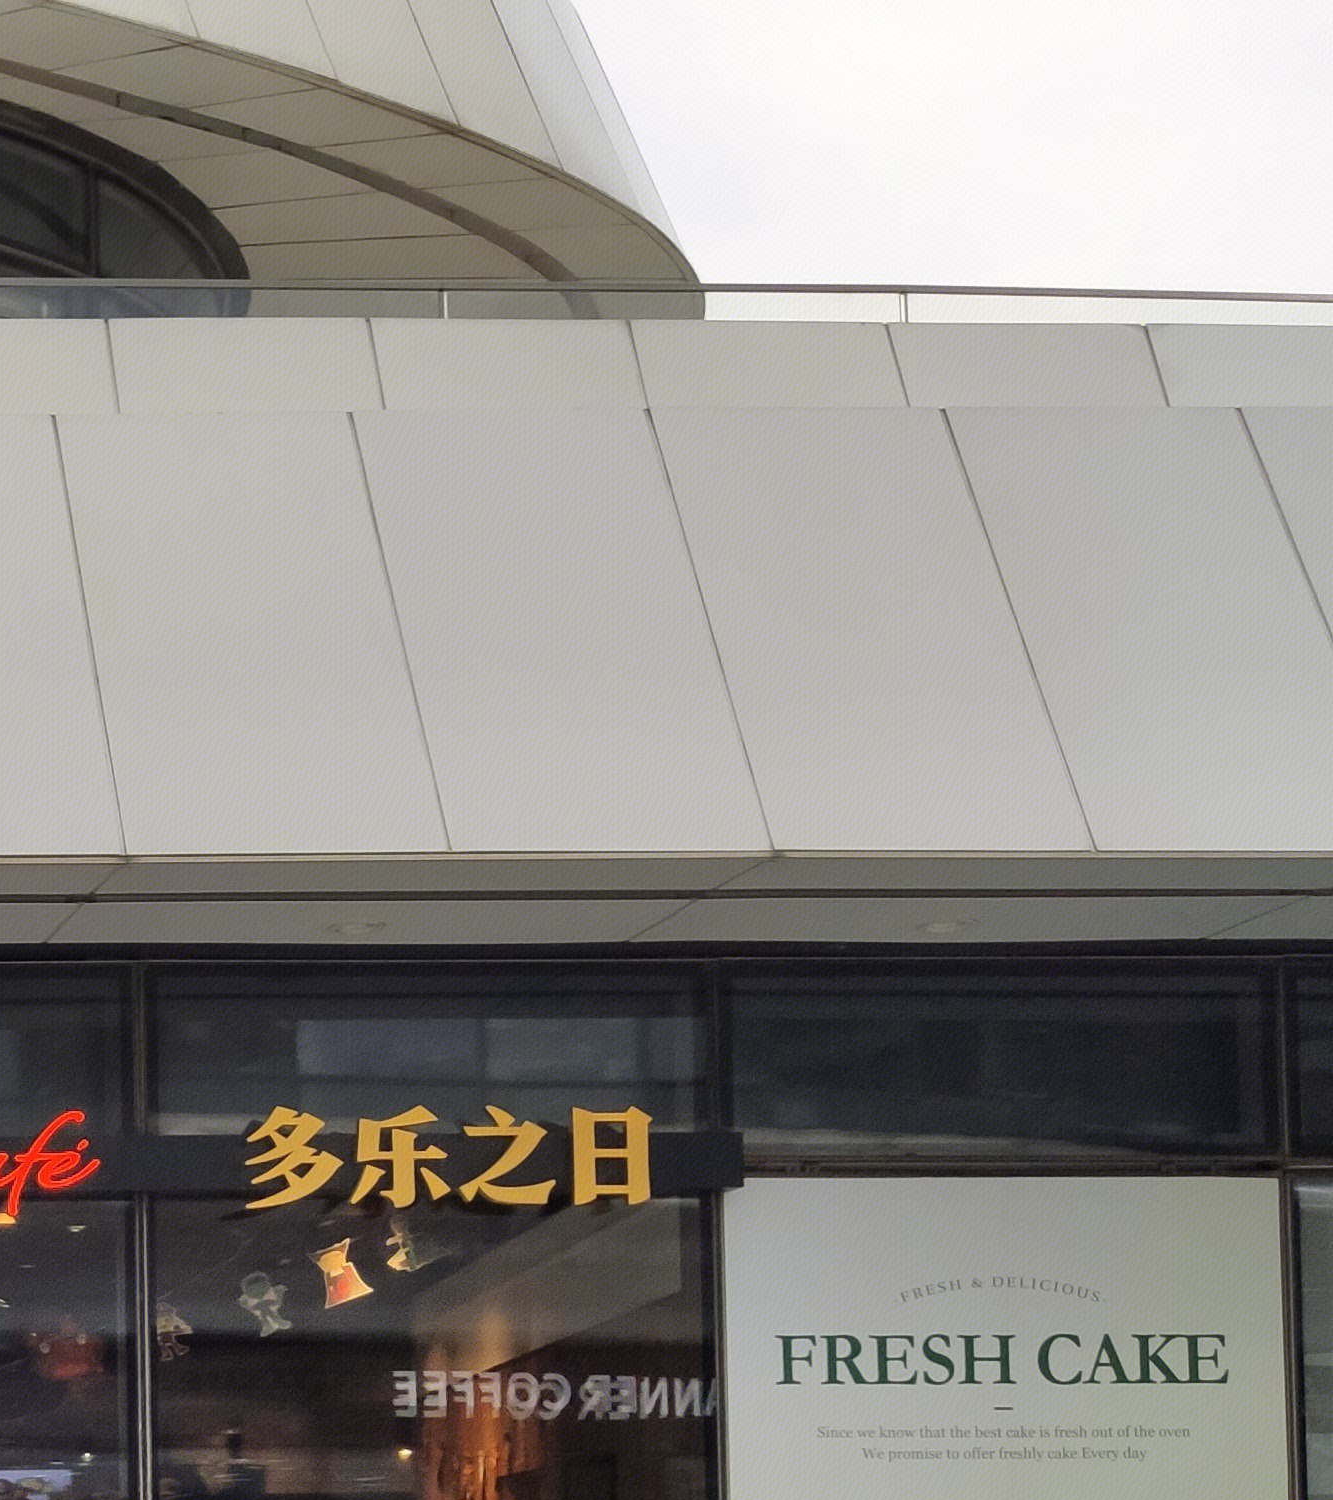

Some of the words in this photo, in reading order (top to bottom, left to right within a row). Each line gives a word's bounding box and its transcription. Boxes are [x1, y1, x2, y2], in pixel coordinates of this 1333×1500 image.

[244, 1104, 654, 1210] 多乐之日
[900, 1278, 962, 1303] FRESH
[971, 1277, 983, 1288] &
[992, 1276, 1100, 1302] DELICIOUS
[775, 1333, 1016, 1385] FRESH
[1037, 1332, 1230, 1385] CAKE
[817, 1426, 854, 1438] Since
[857, 1429, 875, 1438] we
[880, 1426, 915, 1438] know
[919, 1426, 945, 1438] that
[950, 1426, 971, 1438] the
[975, 1426, 1002, 1438] best
[1006, 1426, 1036, 1438] cake
[1040, 1426, 1050, 1438] is
[1054, 1425, 1087, 1438] fresh
[1091, 1427, 1112, 1438] out
[1117, 1425, 1132, 1438] of
[1134, 1426, 1155, 1438] the
[1158, 1428, 1190, 1438] oven
[862, 1447, 884, 1459] We
[889, 1447, 942, 1462] promise
[947, 1448, 959, 1459] to
[963, 1447, 995, 1459] offer
[999, 1447, 1043, 1462] freshly
[1047, 1447, 1077, 1459] cake
[1082, 1448, 1118, 1462] Every
[1123, 1447, 1147, 1461] day
